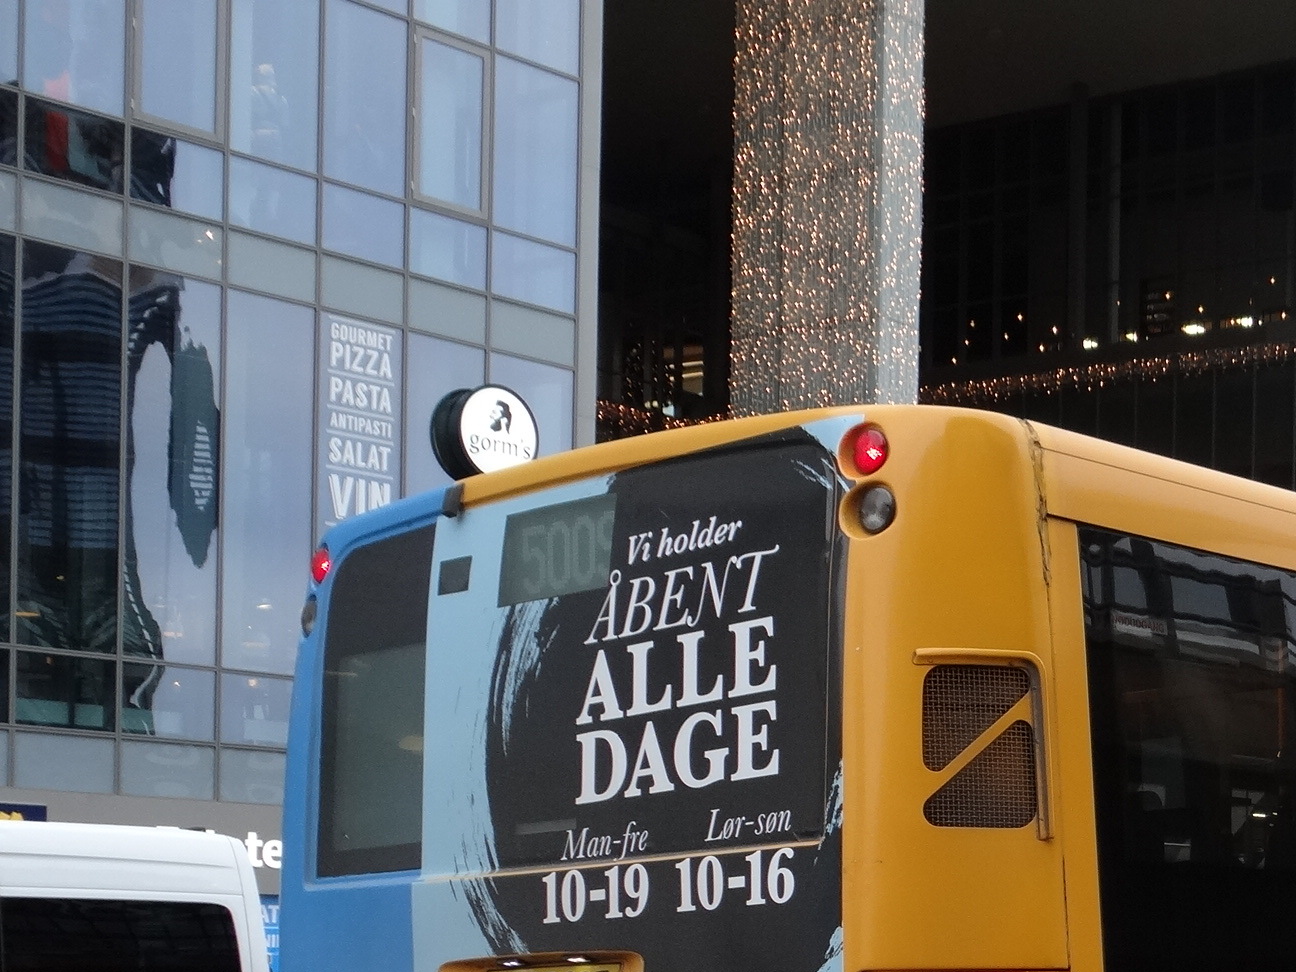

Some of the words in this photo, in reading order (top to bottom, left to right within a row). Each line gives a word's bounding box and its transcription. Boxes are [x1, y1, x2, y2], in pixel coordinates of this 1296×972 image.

[330, 322, 394, 350] GOURMET
[329, 341, 393, 379] PIZZA
[329, 376, 392, 414] PASTA
[330, 411, 392, 439] ANTIPASTI
[468, 433, 532, 460] gorm's
[328, 437, 391, 472] SALAT
[328, 473, 391, 520] VIN
[627, 531, 653, 565] Vi
[657, 515, 743, 558] holder
[583, 544, 780, 646] ÅBENT
[575, 616, 778, 725] ALLE
[575, 700, 780, 806] DAGE
[560, 820, 650, 862] Man-fre
[704, 808, 792, 842] Lør-søn
[541, 862, 650, 924] 10-19
[675, 847, 796, 913] 10-16
